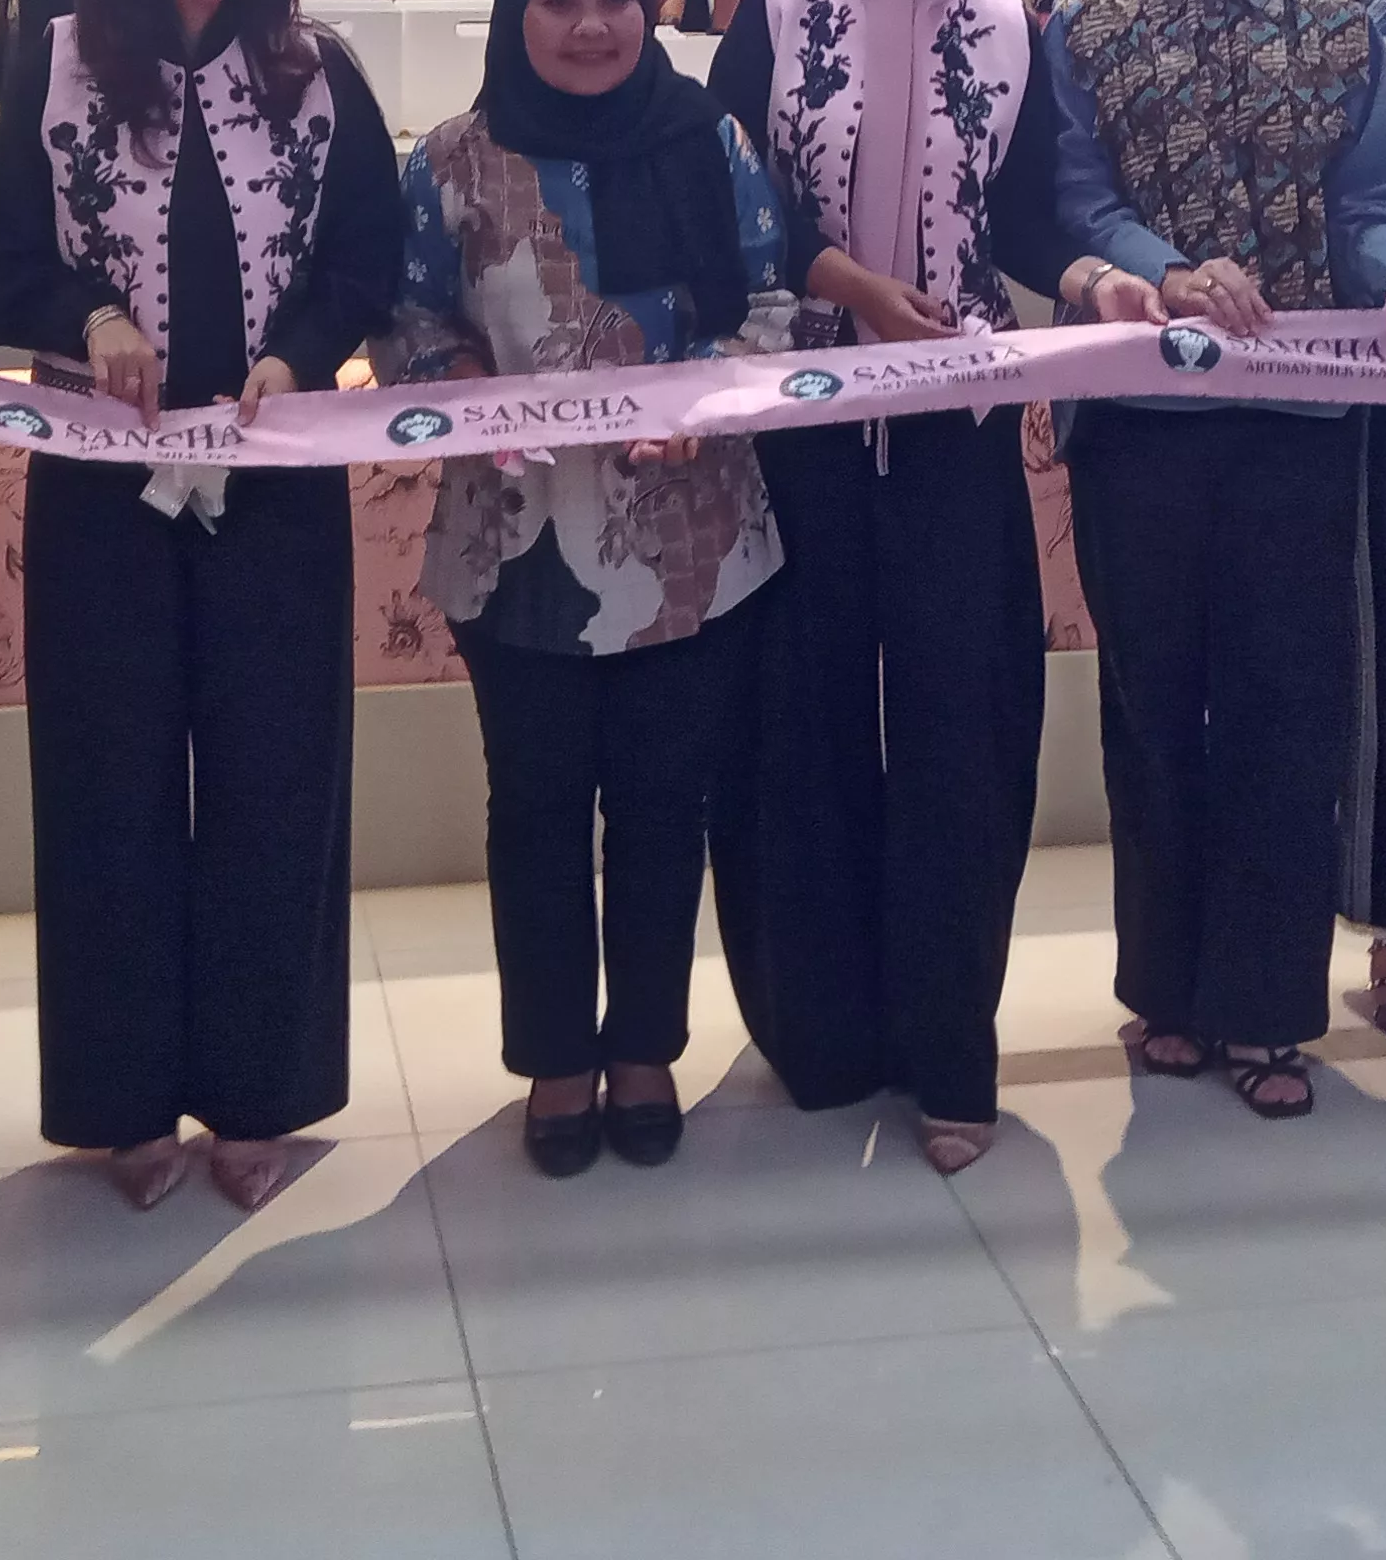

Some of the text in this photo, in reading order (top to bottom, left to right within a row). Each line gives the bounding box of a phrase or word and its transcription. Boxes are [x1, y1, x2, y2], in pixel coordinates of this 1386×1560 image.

[1245, 359, 1312, 376] ARTISAN
[1315, 361, 1355, 378] MILK
[463, 392, 644, 425] SANCHA
